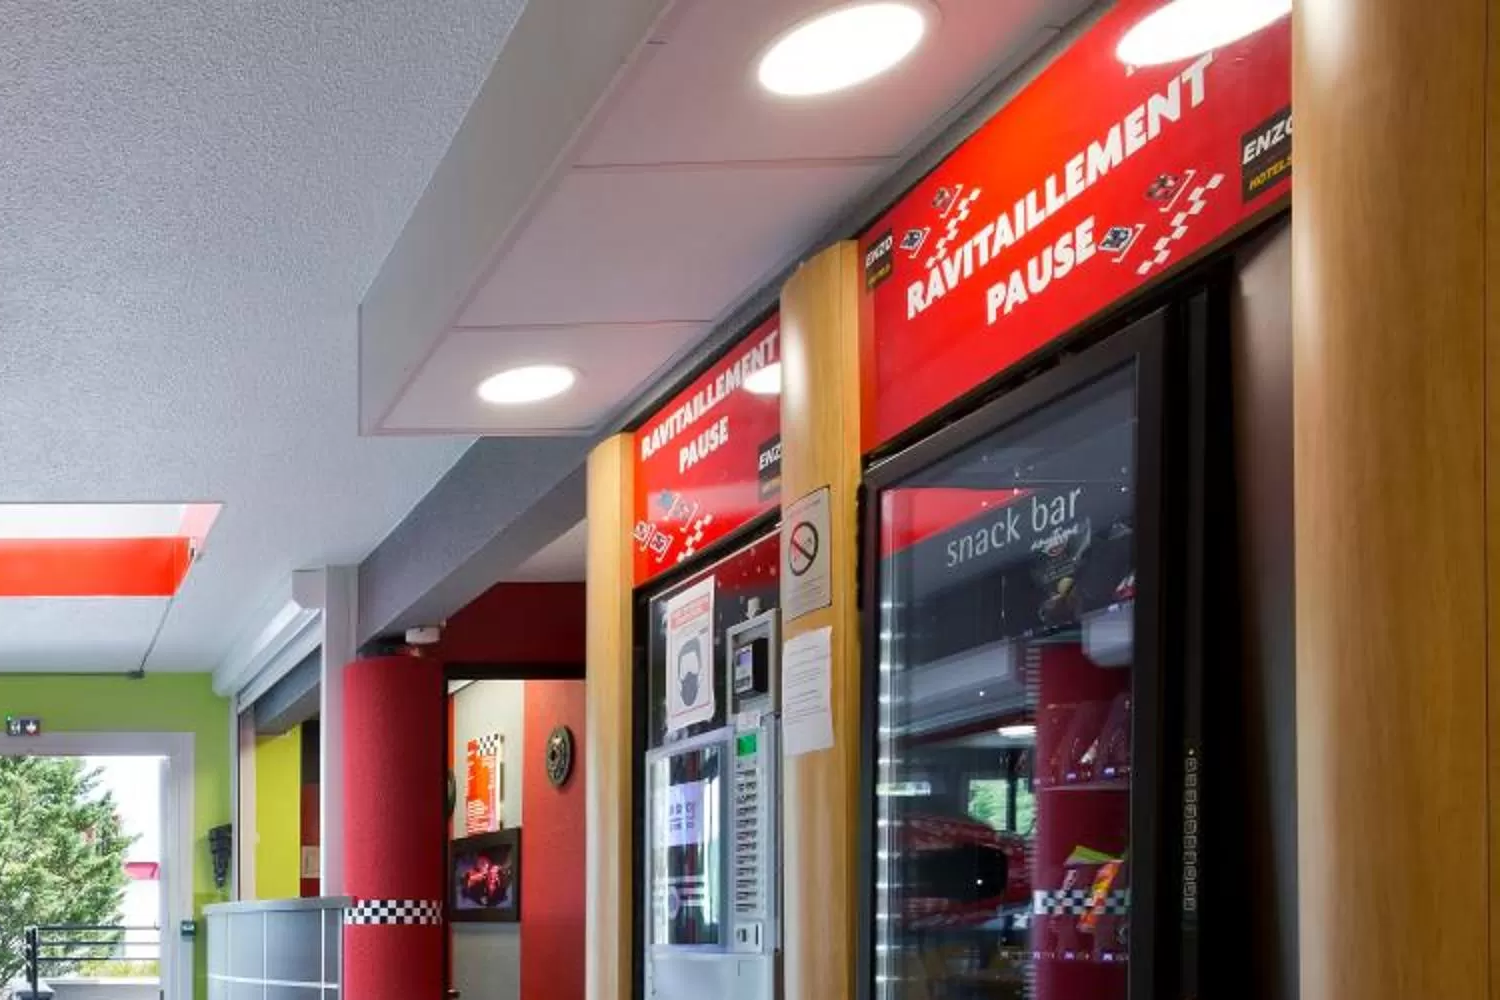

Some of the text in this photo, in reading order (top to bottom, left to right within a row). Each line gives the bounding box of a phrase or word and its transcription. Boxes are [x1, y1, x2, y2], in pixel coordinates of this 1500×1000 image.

[906, 51, 1214, 321] RAVITAILLEMENT
[986, 214, 1098, 326] PAUSE
[640, 329, 779, 462] RAVITAILLEMENT
[678, 415, 730, 475] PAUSE
[946, 486, 1082, 568] snack bar
